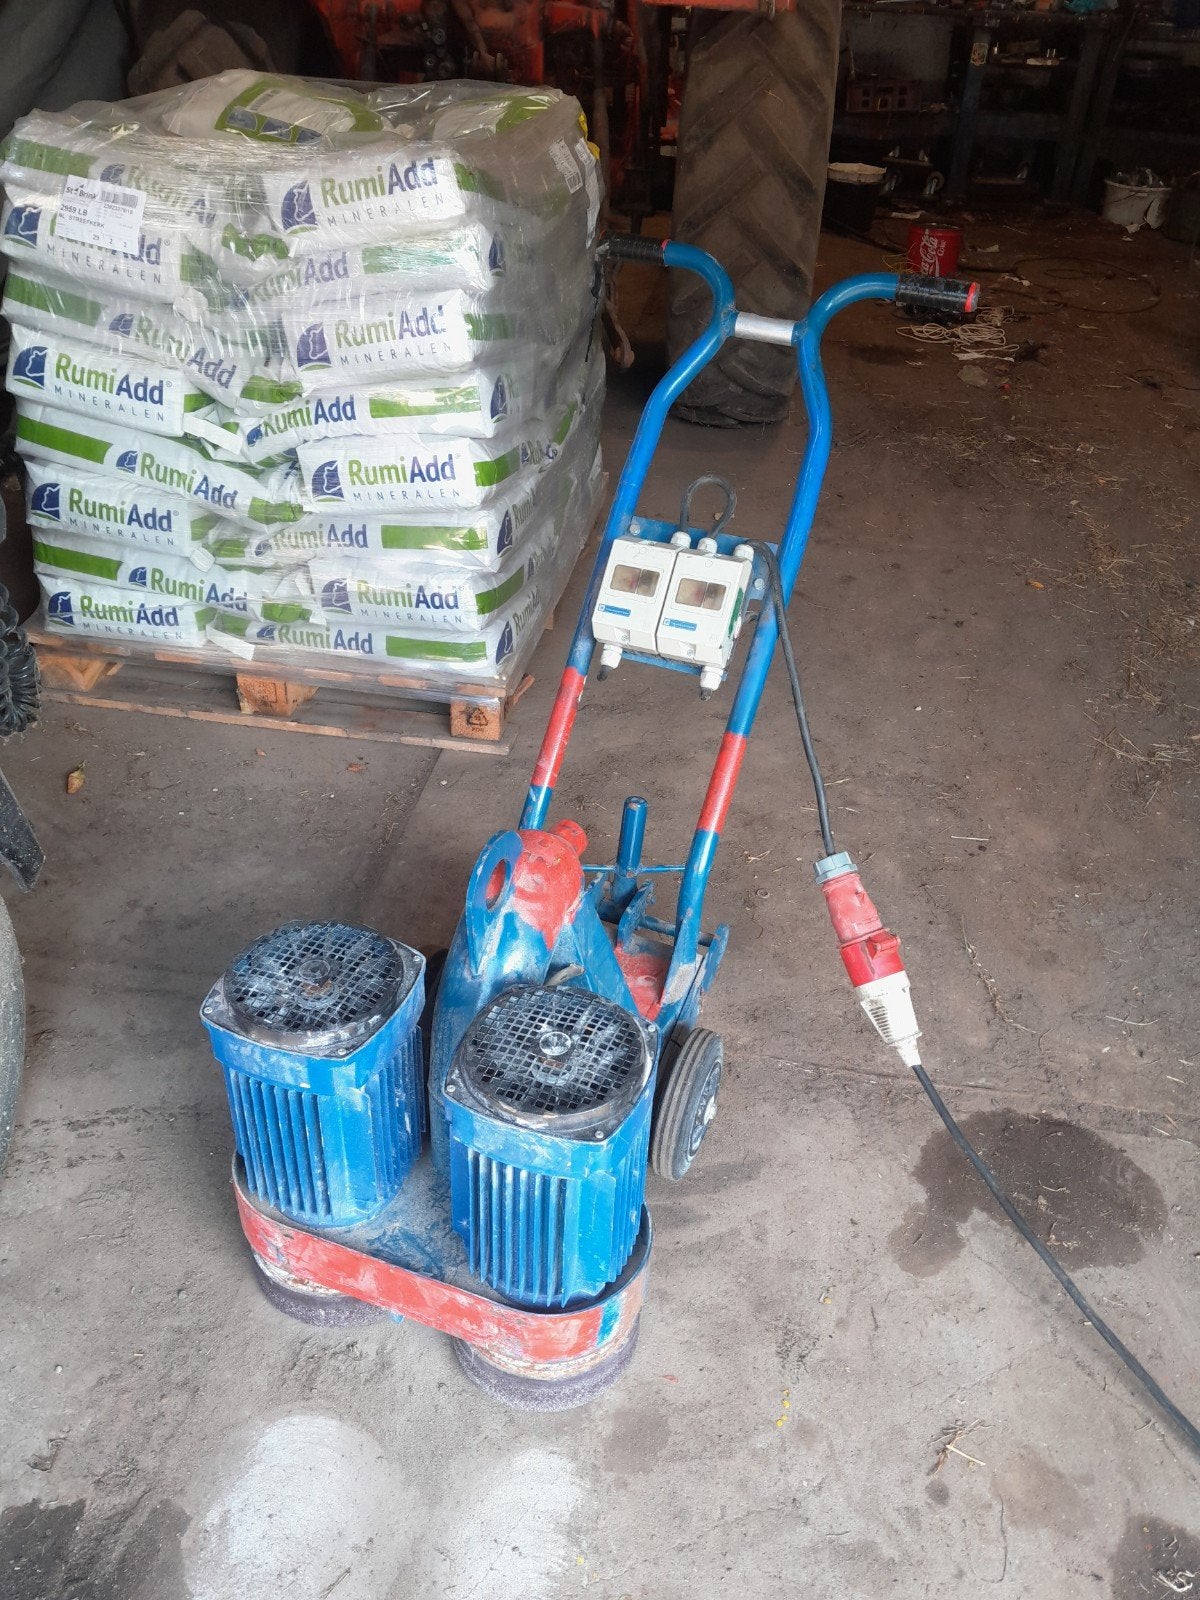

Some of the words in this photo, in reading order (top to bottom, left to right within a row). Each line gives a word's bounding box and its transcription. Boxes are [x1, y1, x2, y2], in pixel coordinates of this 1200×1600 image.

[321, 157, 437, 208] RumiAdd
[325, 192, 445, 227] MINERALEN
[46, 243, 161, 284] MINERALEN
[55, 352, 164, 406] RumiAdd
[53, 384, 165, 422] MINERALEN
[140, 452, 239, 510] RumiAdd
[348, 453, 456, 486] RumiAdd
[69, 487, 173, 532] RumiAdd
[352, 487, 460, 502] MINERALEN
[69, 516, 175, 546] MINERALEN
[150, 567, 248, 612] RumiAdd
[356, 579, 460, 610] RumiAdd
[79, 595, 180, 627] RumiAdd
[360, 608, 464, 624] MINERALEN
[82, 621, 183, 640] MINERALEN
[278, 624, 374, 655] RumiAdd
